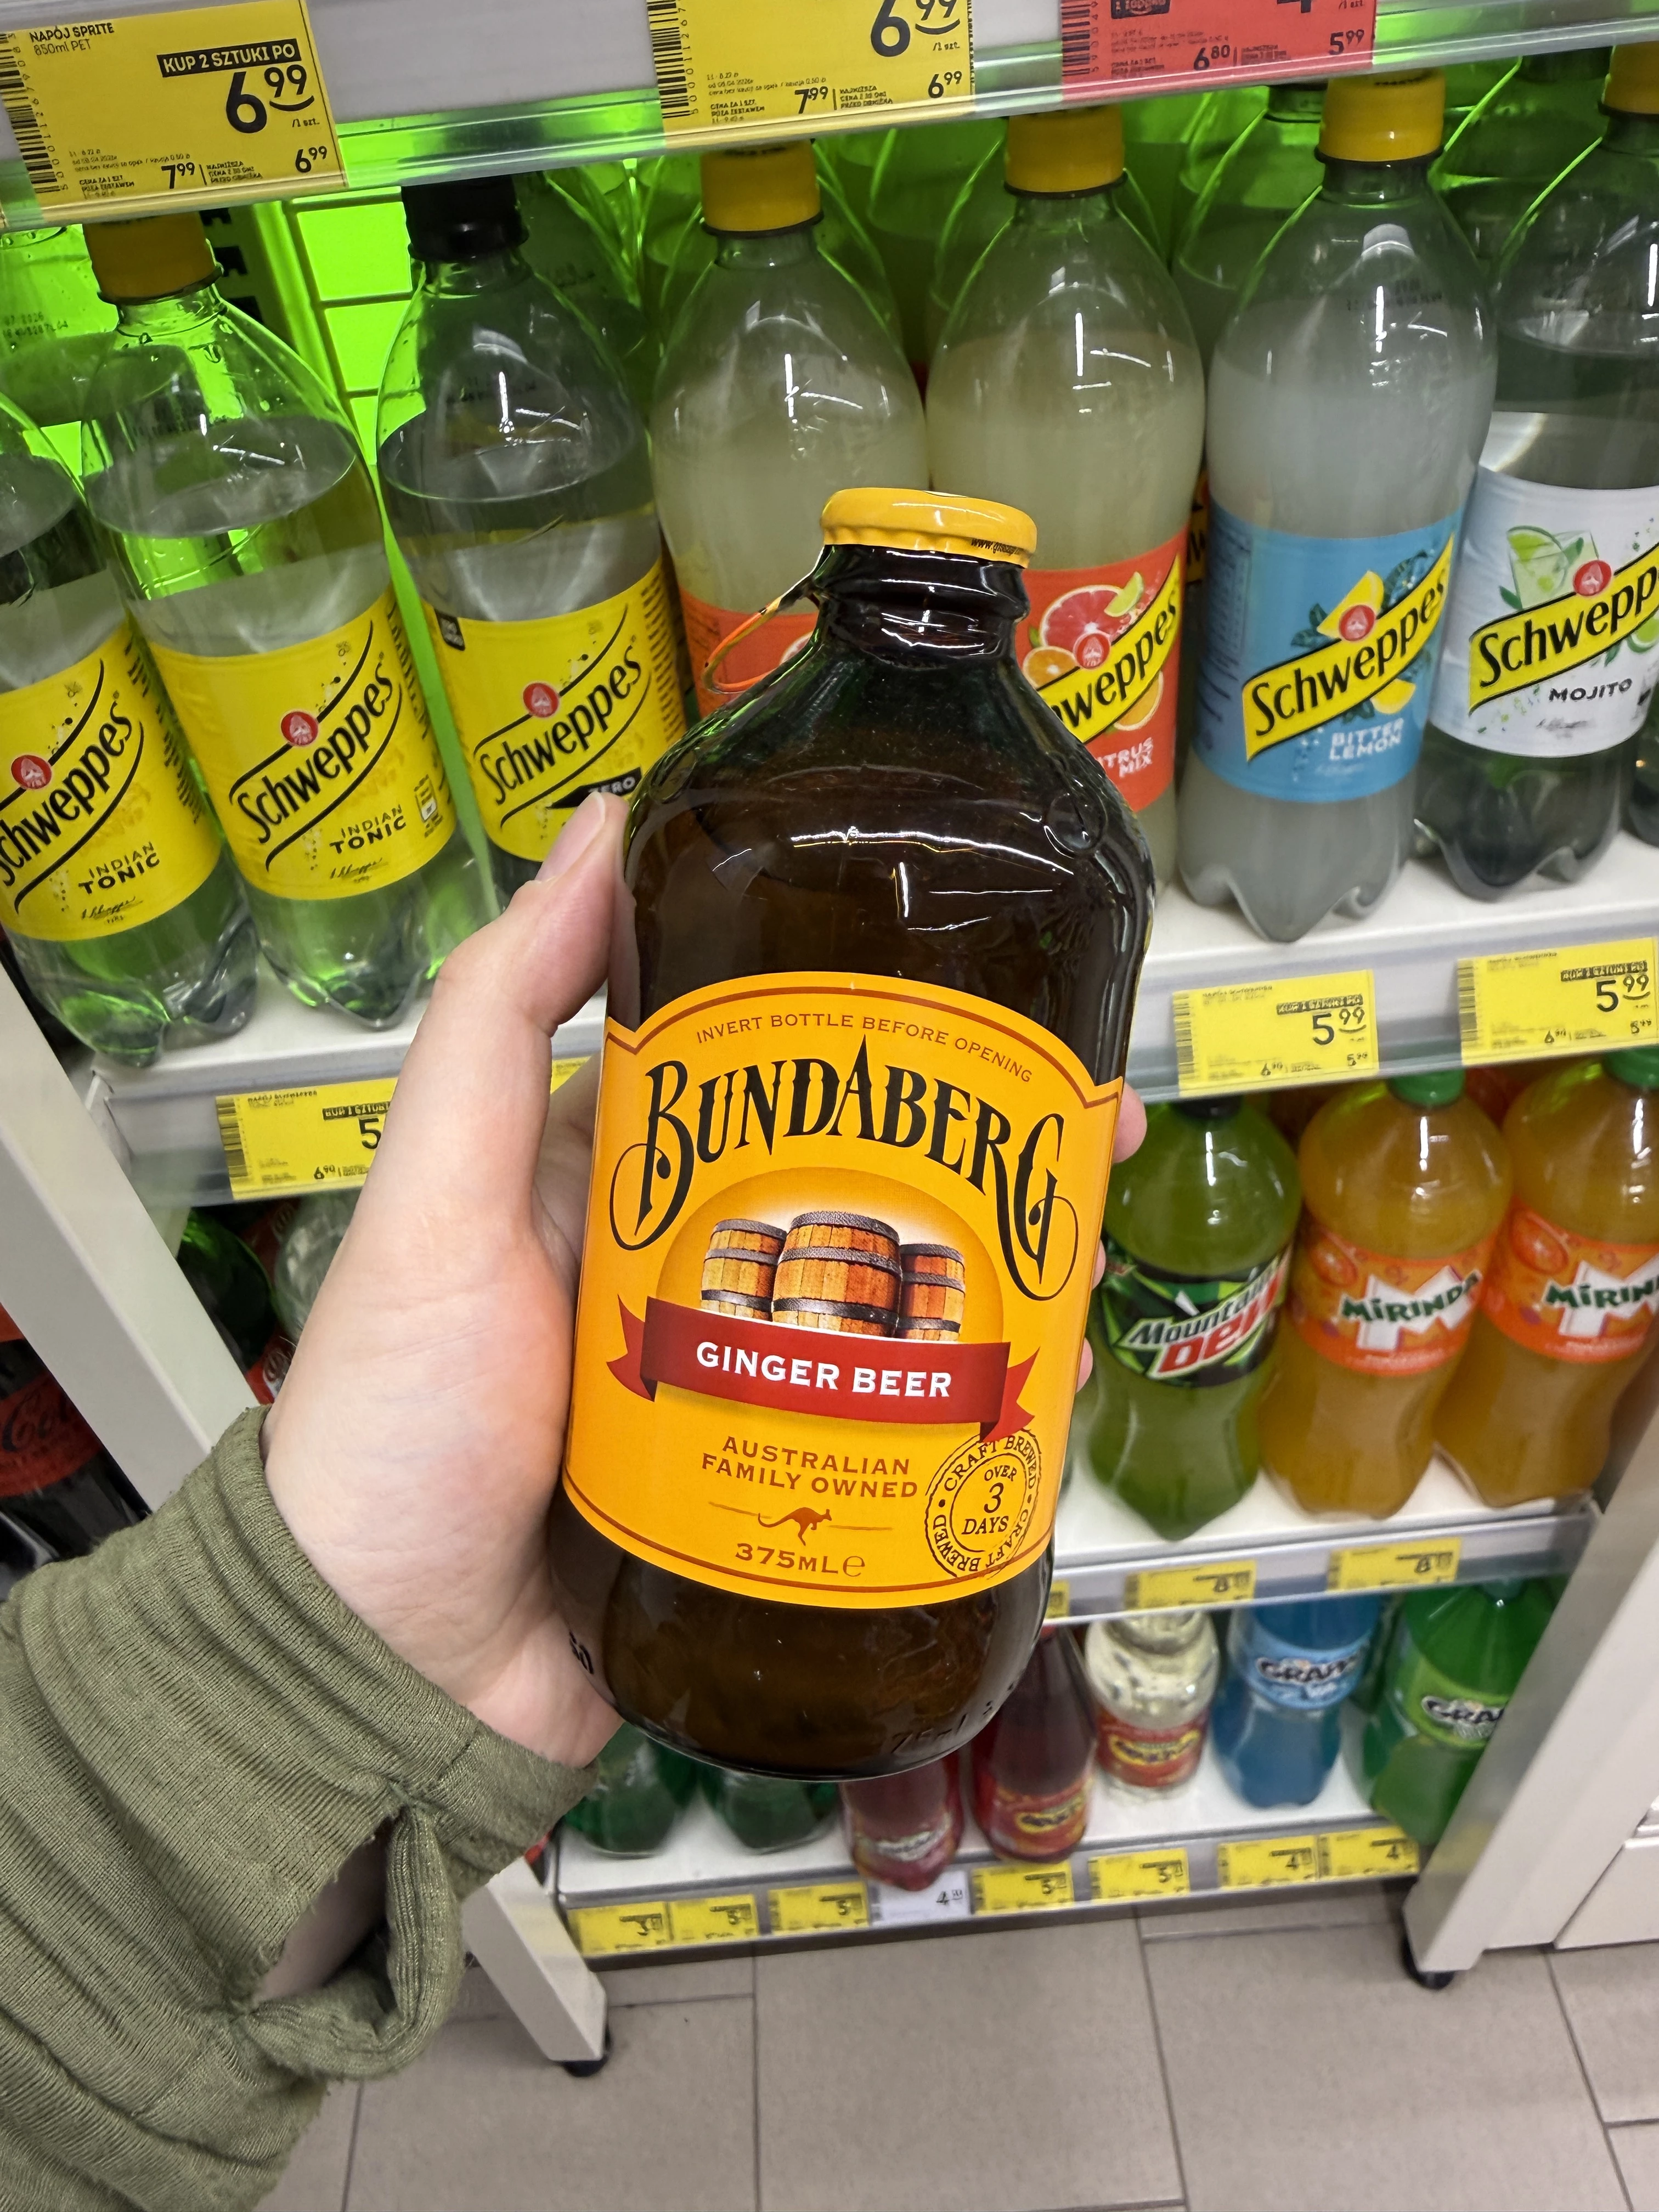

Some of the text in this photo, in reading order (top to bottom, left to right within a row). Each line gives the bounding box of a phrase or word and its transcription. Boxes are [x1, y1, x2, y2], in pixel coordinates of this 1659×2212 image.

[29, 22, 114, 42] NAPÓJ SPRITE
[71, 39, 91, 50] PET
[163, 43, 295, 73] KUP 2 SZTUKI PO
[1480, 566, 1659, 689] Schwepp
[1251, 565, 1448, 737] Schweppes
[1549, 678, 1633, 702] MOJITO
[479, 644, 642, 806] Schweppes
[236, 661, 393, 844] Schweppes
[329, 818, 407, 854] TONIC
[340, 803, 402, 838] INDIAN
[77, 852, 161, 894] TONIC
[89, 842, 155, 878] INDIAN
[697, 1013, 1033, 1082] INVERT BOTTLE BEFORE OPENING
[609, 1034, 1079, 1302] BUNDABERG
[697, 1342, 951, 1397] GINGER BEER
[702, 1453, 918, 1498] FAMILY OWNED
[723, 1436, 910, 1476] AUSTRALIAN
[944, 1435, 1037, 1492] CRAFT BREWED
[984, 1465, 1018, 1482] OVER
[984, 1482, 1004, 1514] 3
[933, 1515, 981, 1572] BREWED
[961, 1516, 1009, 1535] DAYS
[986, 1509, 1029, 1568] CRAFT
